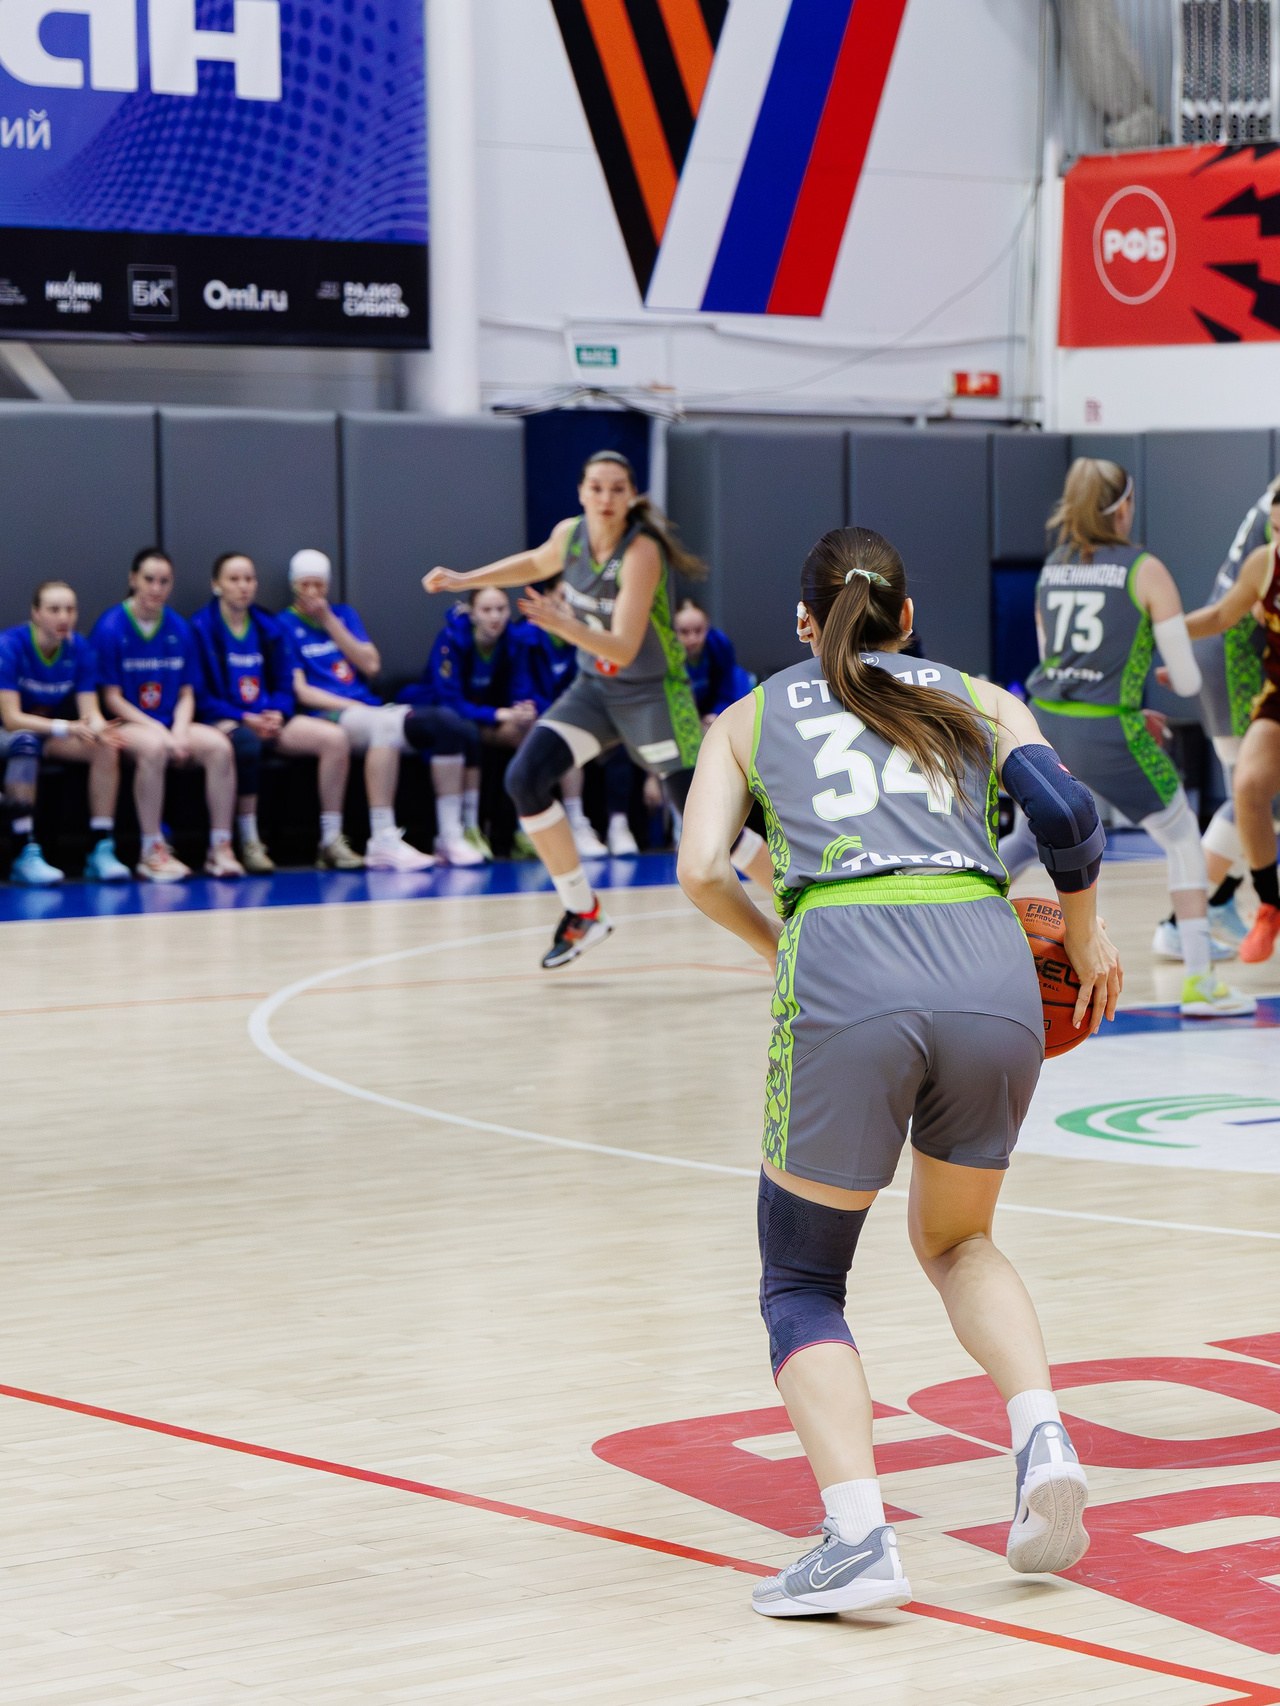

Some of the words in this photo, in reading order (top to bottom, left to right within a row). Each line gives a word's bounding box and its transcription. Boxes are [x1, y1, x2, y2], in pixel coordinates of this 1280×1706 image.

[1103, 226, 1166, 263] РФБ
[1046, 590, 1106, 654] 73
[795, 711, 955, 822] 34
[1027, 903, 1063, 920] FIBA
